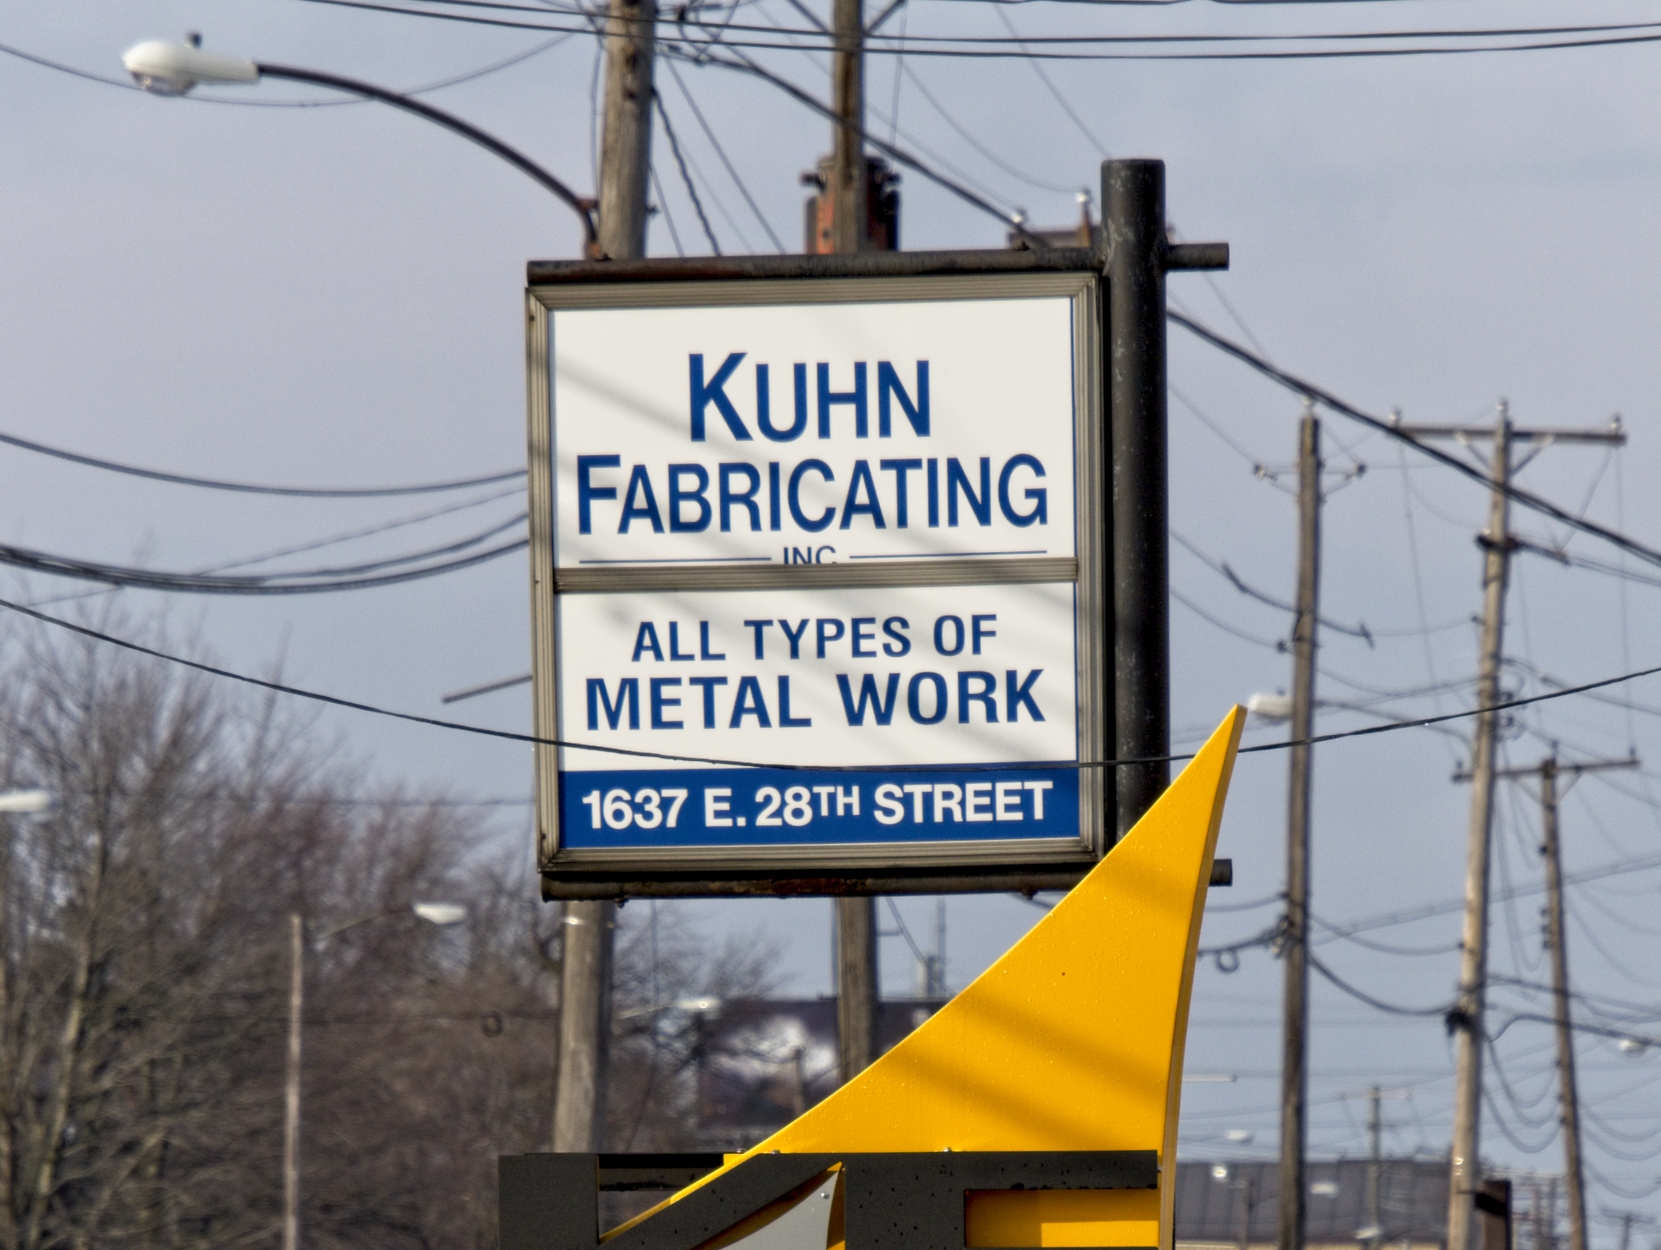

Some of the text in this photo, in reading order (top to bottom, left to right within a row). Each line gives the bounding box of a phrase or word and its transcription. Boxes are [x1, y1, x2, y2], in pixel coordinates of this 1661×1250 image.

[690, 353, 930, 442] KUHN
[578, 454, 1047, 534] FABRICATING
[632, 614, 996, 662] ALL TYPES OF
[587, 669, 1045, 730] METAL WORK
[583, 780, 1053, 829] 1637 E. 28TH STREET
